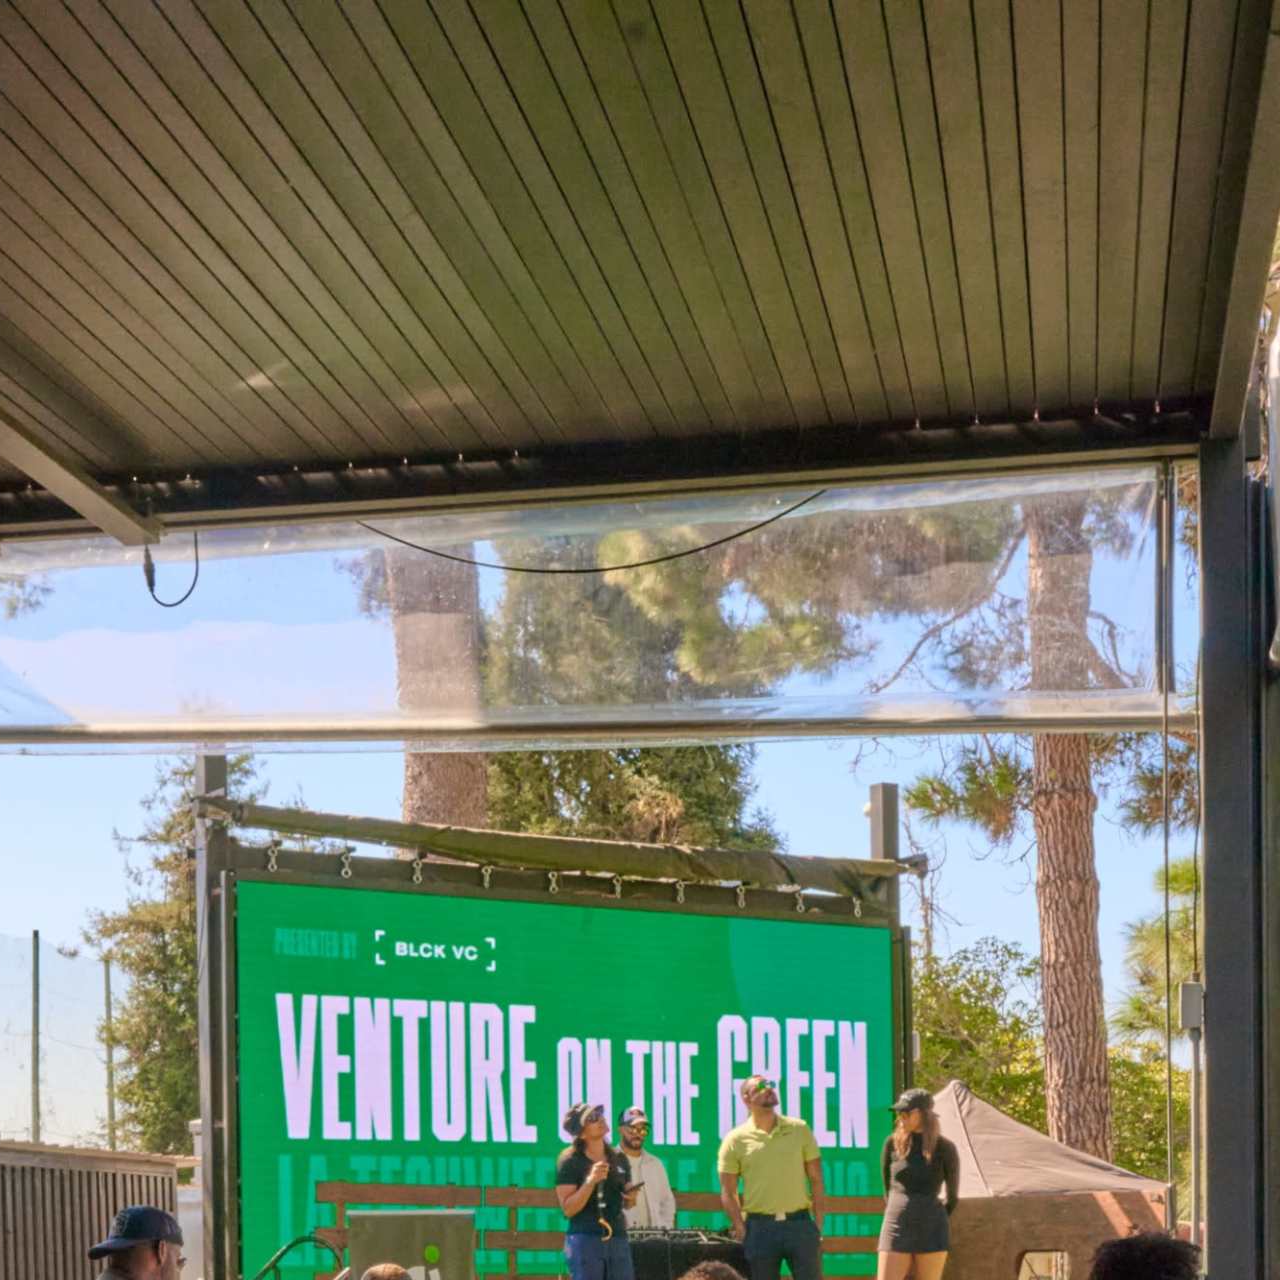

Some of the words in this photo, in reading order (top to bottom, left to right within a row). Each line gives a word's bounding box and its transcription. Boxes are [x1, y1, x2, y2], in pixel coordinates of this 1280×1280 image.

[394, 941, 446, 959] BLCK
[452, 945, 479, 961] VC
[274, 992, 538, 1143] VENTURE
[557, 1036, 613, 1144] ON
[626, 1039, 701, 1146] THE
